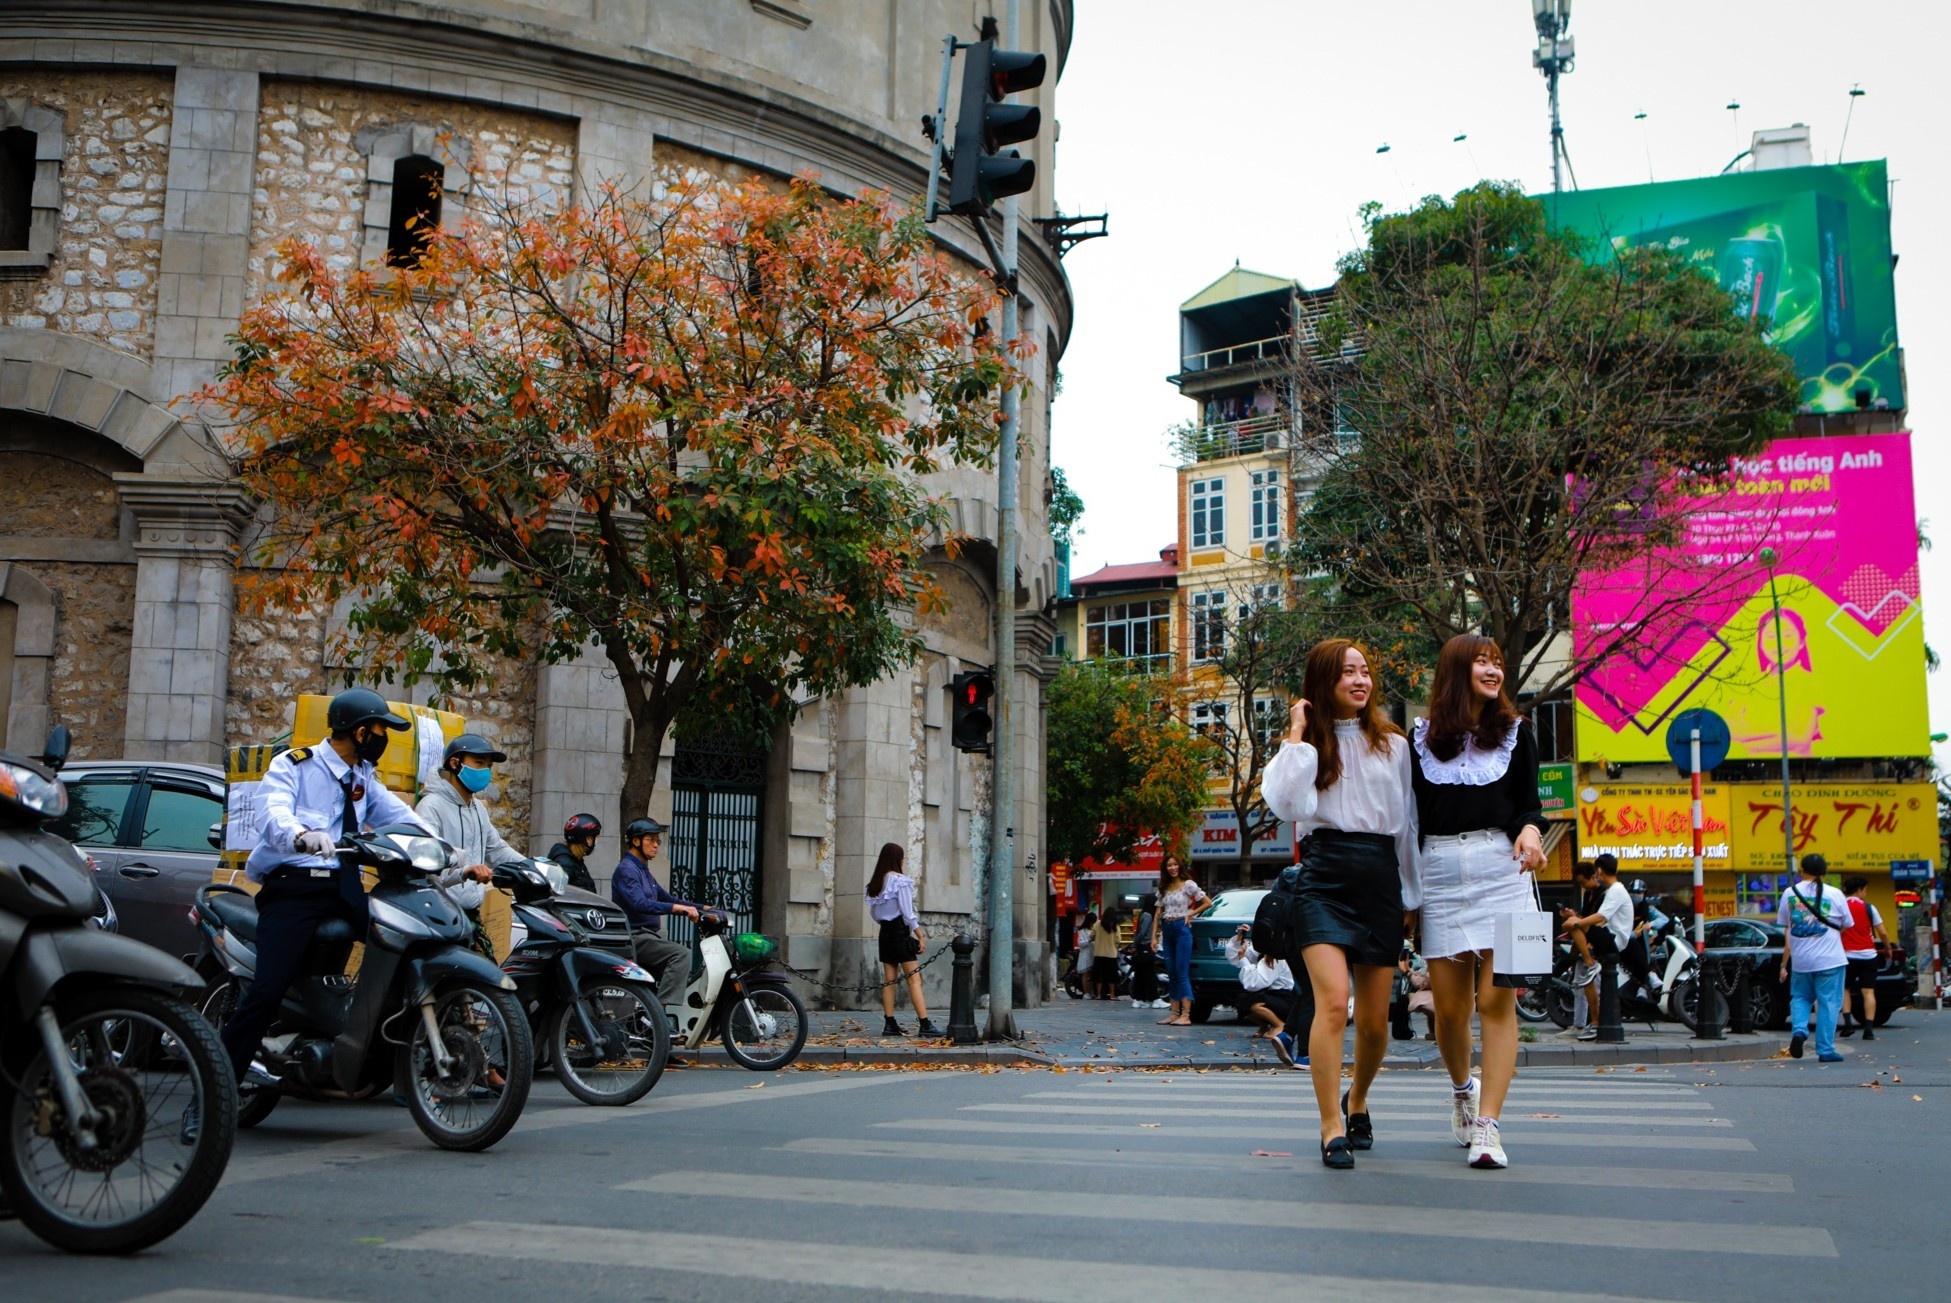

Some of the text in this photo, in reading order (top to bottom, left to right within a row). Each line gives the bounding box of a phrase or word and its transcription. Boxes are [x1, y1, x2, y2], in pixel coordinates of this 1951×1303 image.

[1779, 451, 1834, 473] tiếng
[1840, 449, 1883, 470] Anh
[1790, 473, 1830, 494] mới
[1538, 786, 1553, 796] NH
[1619, 788, 1626, 796] TY
[1616, 803, 1648, 838] Sào
[1649, 803, 1687, 838] Việt
[1203, 829, 1237, 842] KIM
[1581, 843, 1600, 860] NHÀ
[1621, 842, 1645, 860] THÁC
[1644, 844, 1667, 862] TRỰC
[1668, 841, 1688, 860] TIẾP
[1688, 846, 1706, 859] SN
[1706, 841, 1728, 860] XUẤT
[521, 949, 539, 957] SYM
